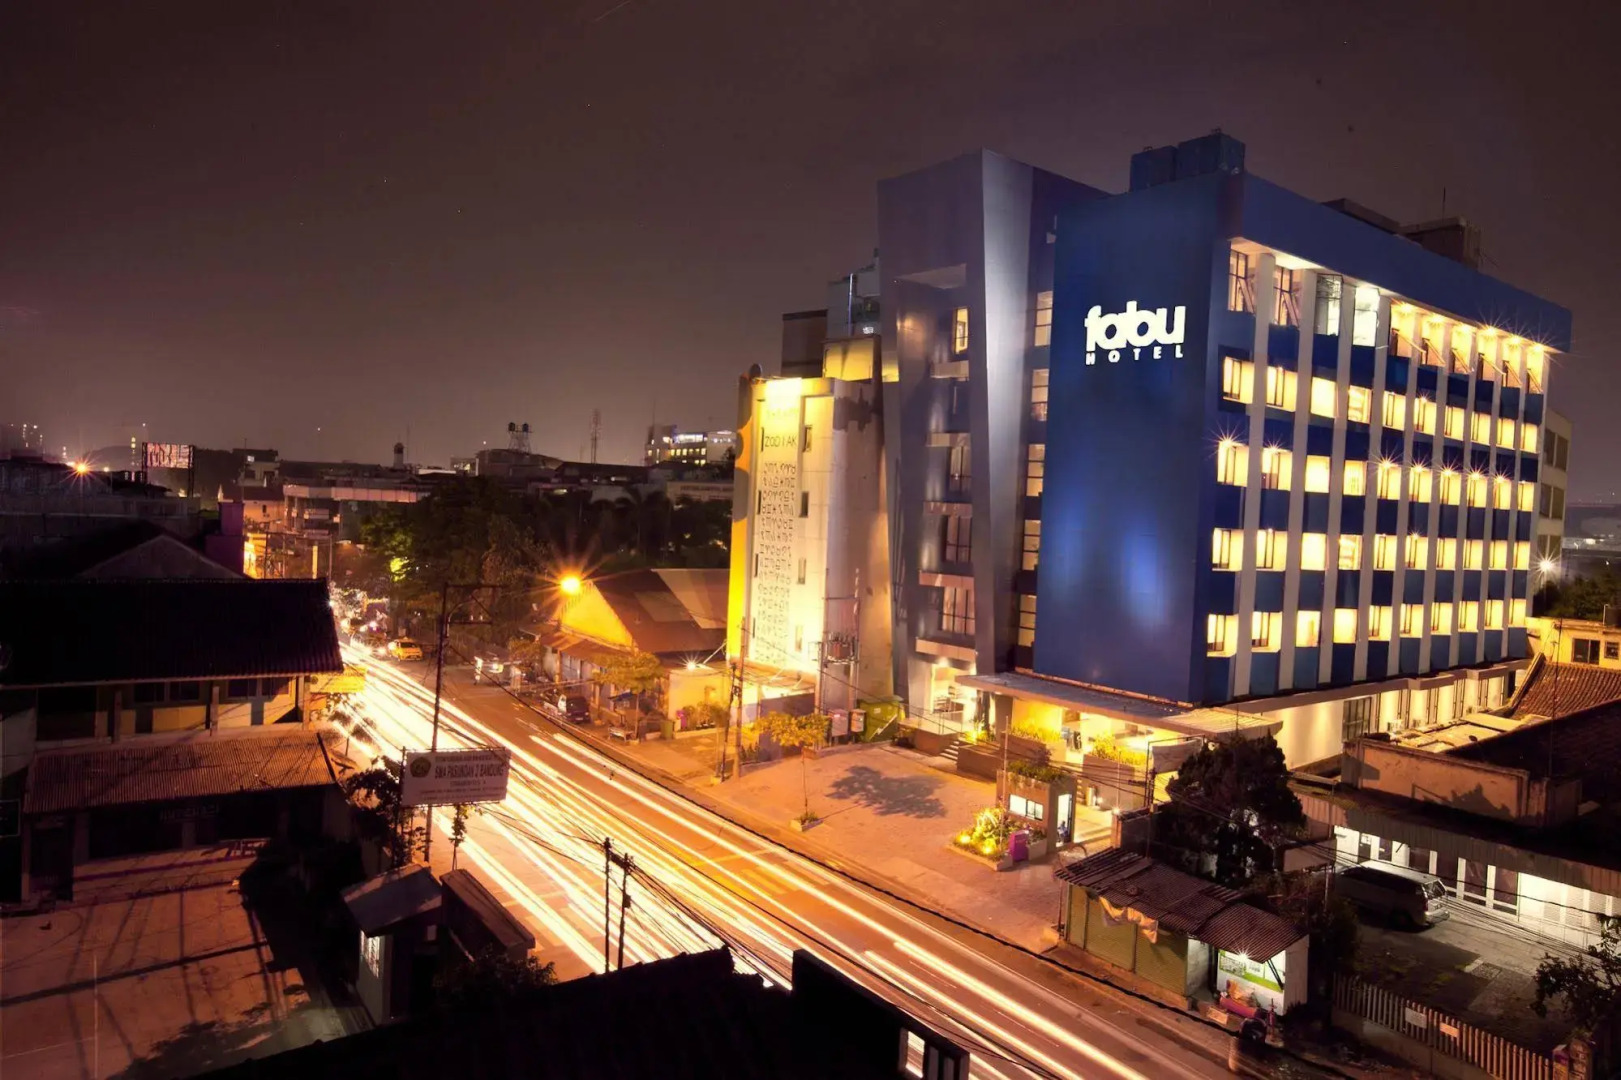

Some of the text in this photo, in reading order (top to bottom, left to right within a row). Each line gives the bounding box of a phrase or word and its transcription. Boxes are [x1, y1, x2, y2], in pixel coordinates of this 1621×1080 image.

[1084, 300, 1186, 352] fabu
[1085, 344, 1184, 366] HOTEL
[764, 434, 798, 448] ZODIAK
